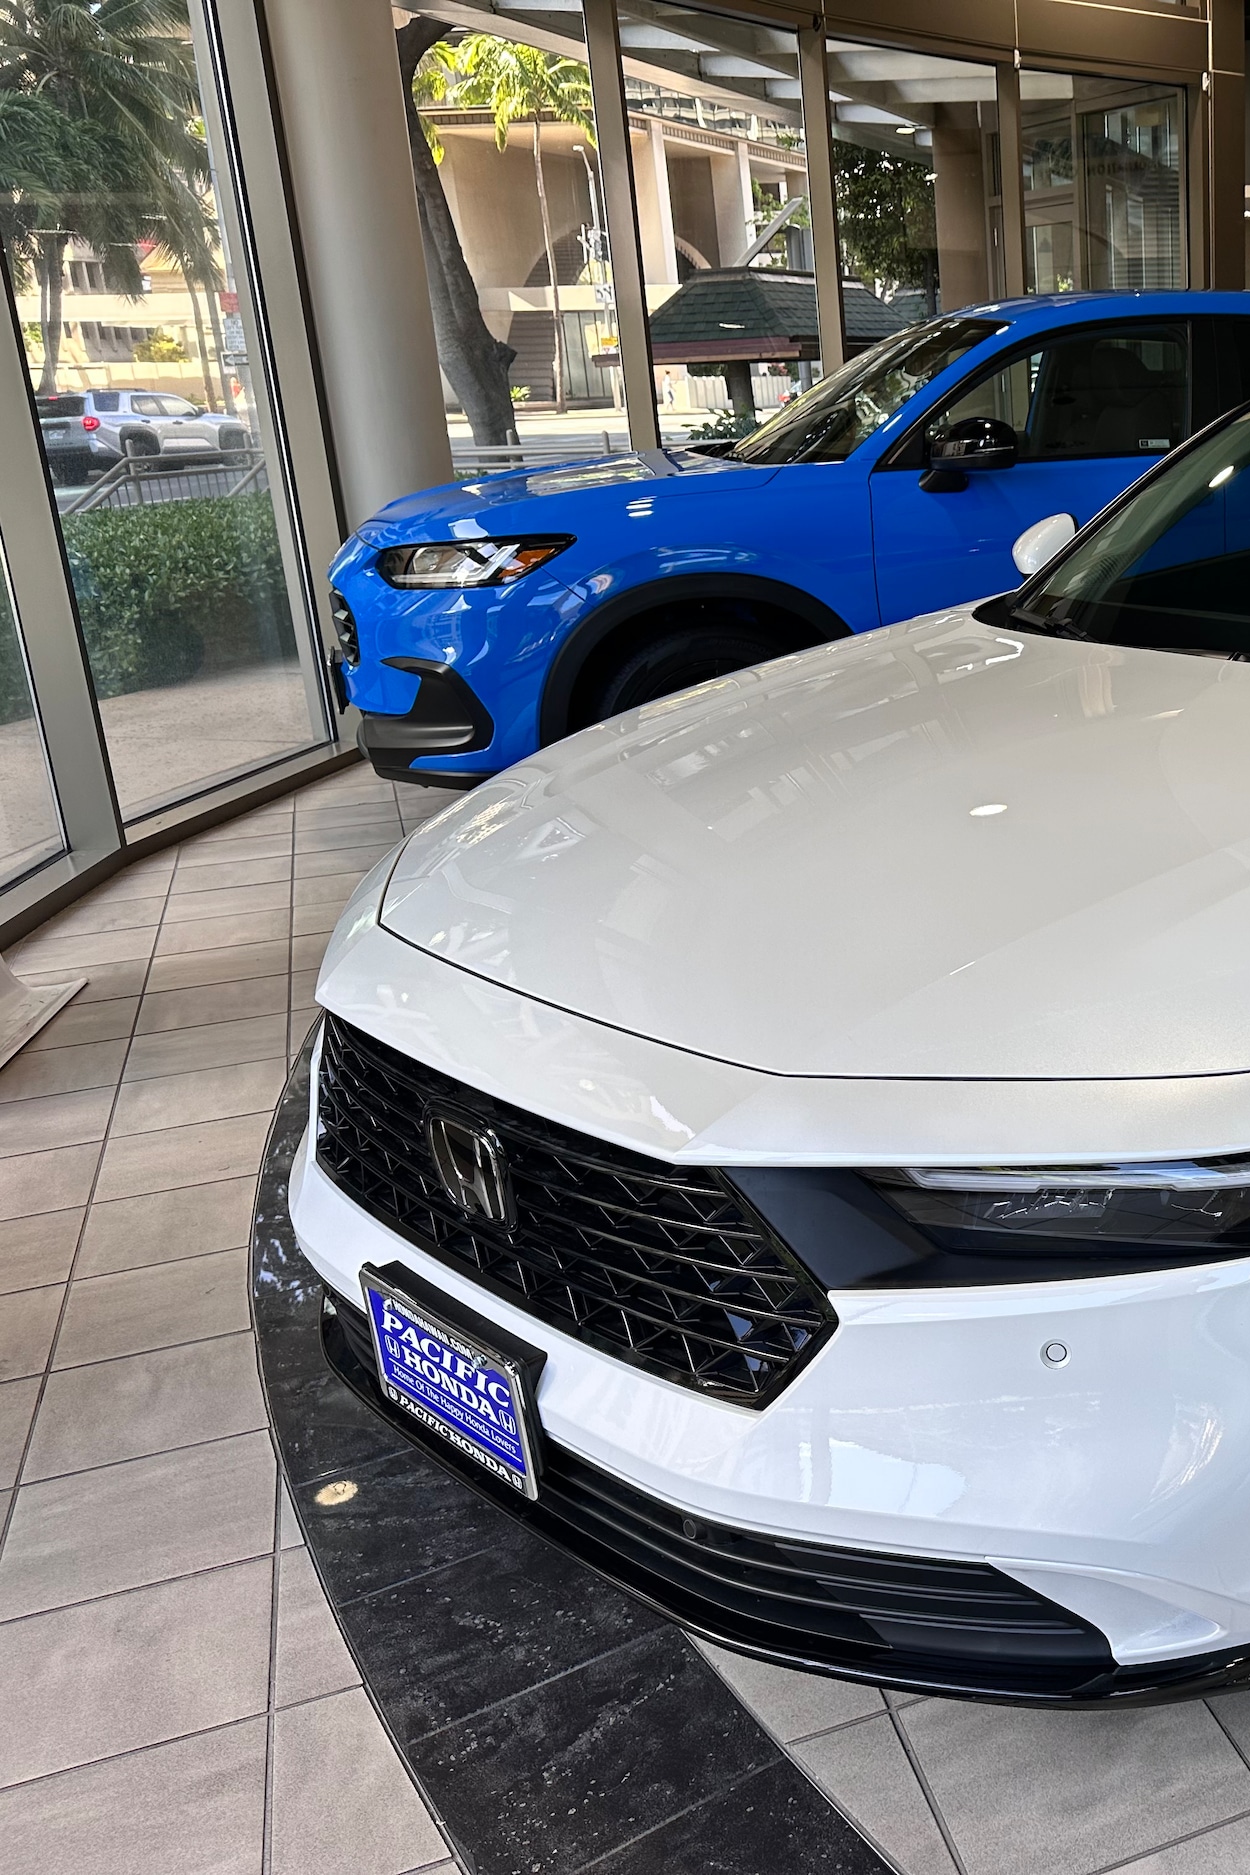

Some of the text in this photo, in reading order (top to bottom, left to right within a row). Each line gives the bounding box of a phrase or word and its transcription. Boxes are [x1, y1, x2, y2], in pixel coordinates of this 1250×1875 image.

[381, 1309, 510, 1407] PACIFIC
[401, 1345, 500, 1425] HONDA
[393, 1364, 517, 1454] Home Of The Happy Honda Lovers
